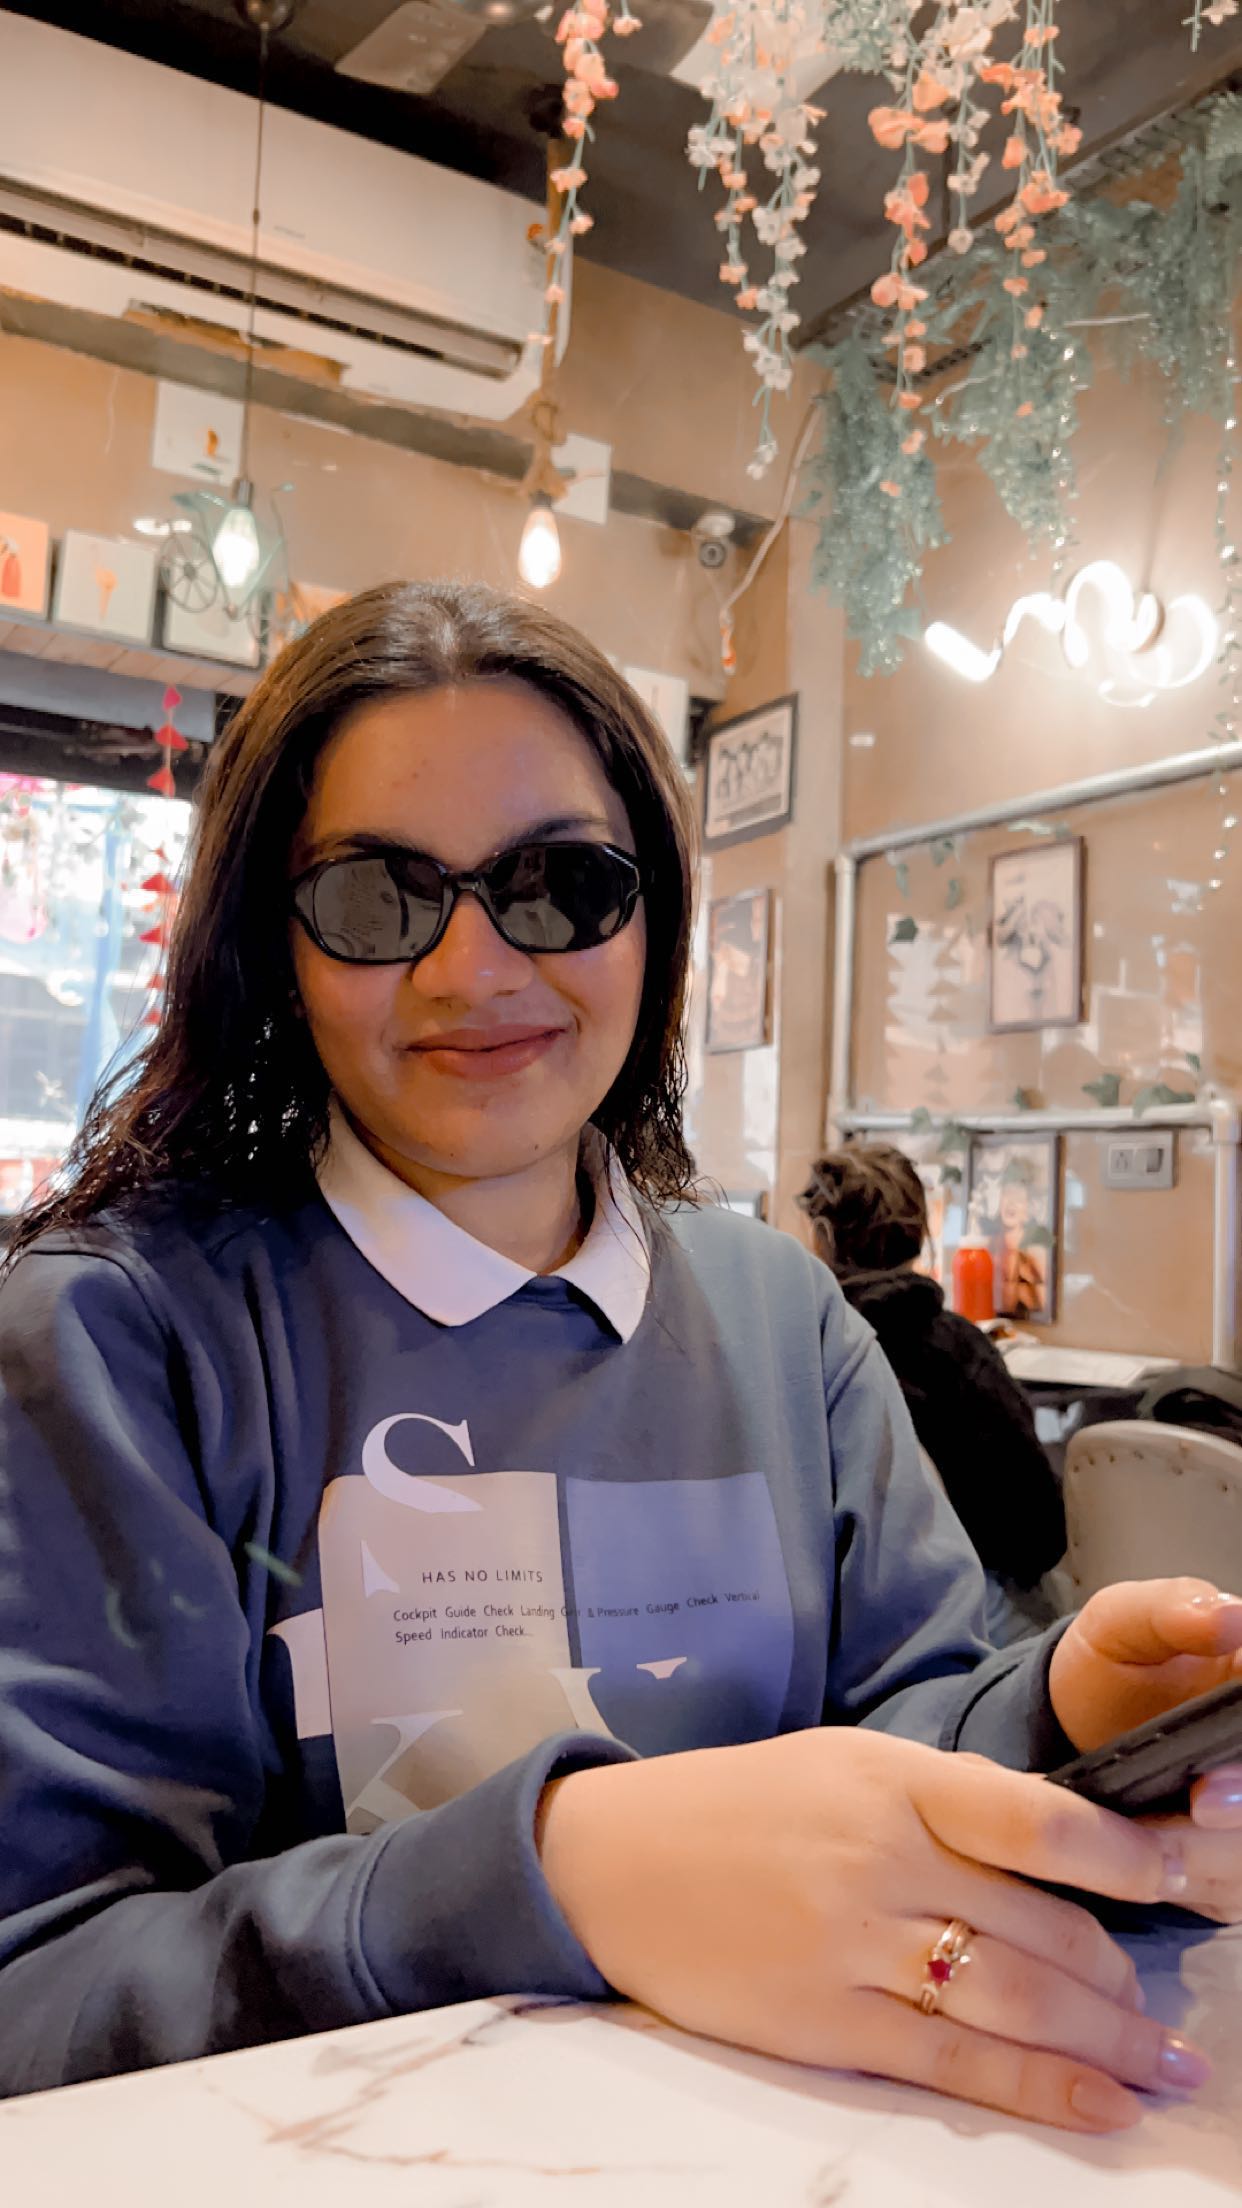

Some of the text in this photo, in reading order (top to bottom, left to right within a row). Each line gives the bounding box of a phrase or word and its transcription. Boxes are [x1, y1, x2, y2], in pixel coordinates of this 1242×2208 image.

[422, 1569, 543, 1583] HAS NO LIMITS
[393, 1607, 437, 1622] Cockpit
[445, 1605, 477, 1618] Guide
[483, 1604, 514, 1617] Check
[520, 1604, 555, 1620] Landing
[597, 1606, 640, 1617] Pressure
[646, 1601, 680, 1616] Gauge
[687, 1594, 718, 1608] Check
[724, 1591, 761, 1603] Vertical
[395, 1628, 432, 1645] Speed
[441, 1626, 489, 1640] Indicator
